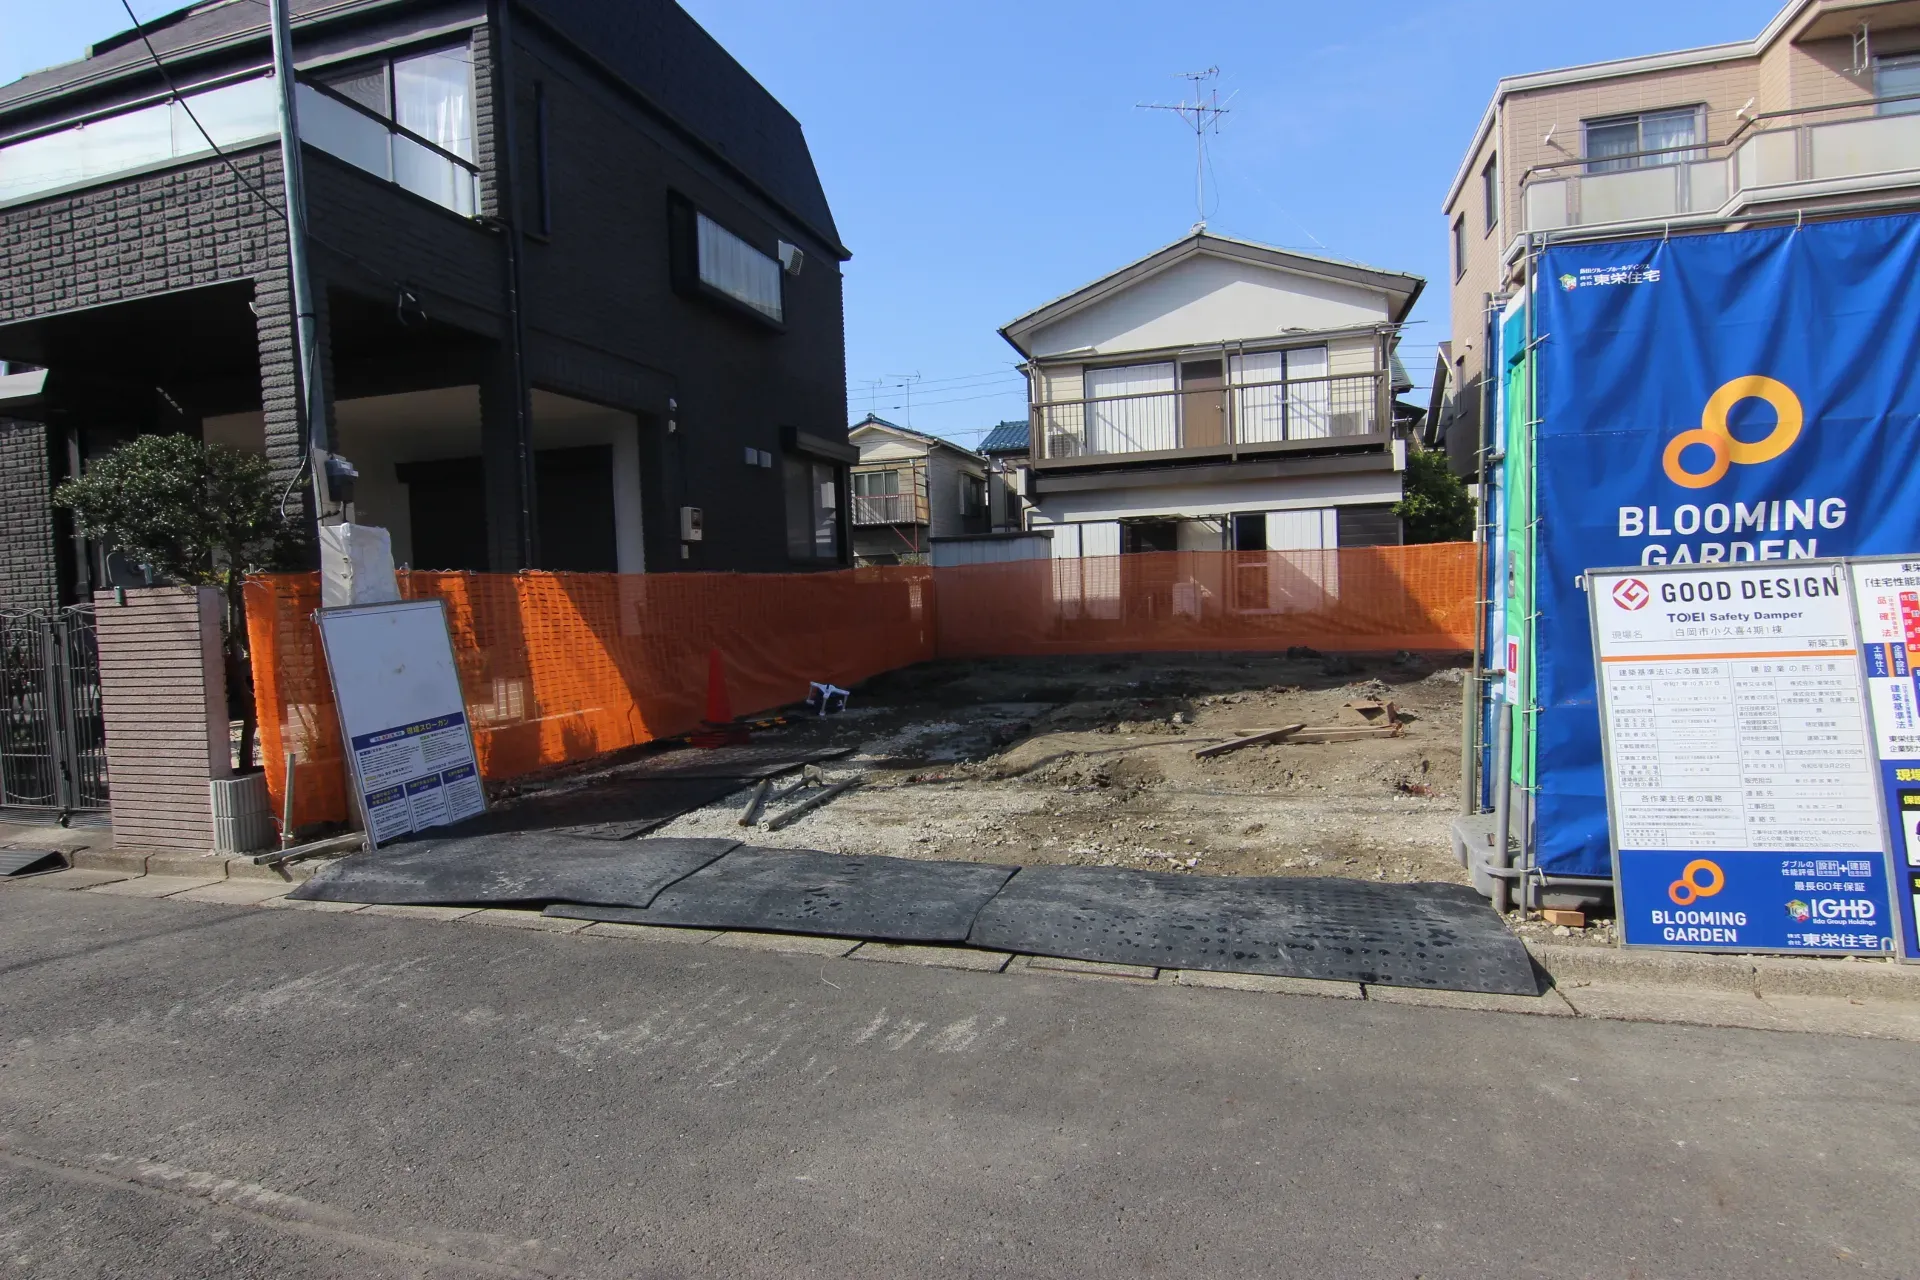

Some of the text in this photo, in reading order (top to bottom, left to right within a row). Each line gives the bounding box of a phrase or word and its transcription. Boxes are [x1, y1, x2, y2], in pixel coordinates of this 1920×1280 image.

[1593, 270, 1661, 286] 東栄住宅
[1618, 498, 1847, 537] BLOOMING
[1641, 539, 1817, 566] GARDEN
[1661, 576, 1840, 603] GOOD DESIGN
[1710, 611, 1750, 623] Safety
[1754, 610, 1804, 621] Damper
[1611, 624, 1784, 639] 現場名 白岡市小久喜4期1棟
[1807, 638, 1849, 648] 新築工事
[1619, 666, 1719, 677] 建築基準法による確認済
[1781, 860, 1814, 869] ダブルの
[1781, 868, 1816, 876] 性能評価
[1794, 881, 1865, 892] 最長60年保証
[1811, 898, 1875, 918] IGHD
[1651, 910, 1747, 926] BLOOMING
[1826, 919, 1848, 927] Group
[1848, 919, 1877, 927] Holdings
[1663, 927, 1738, 943] GARDEN
[1802, 932, 1878, 948] 東栄住宅
